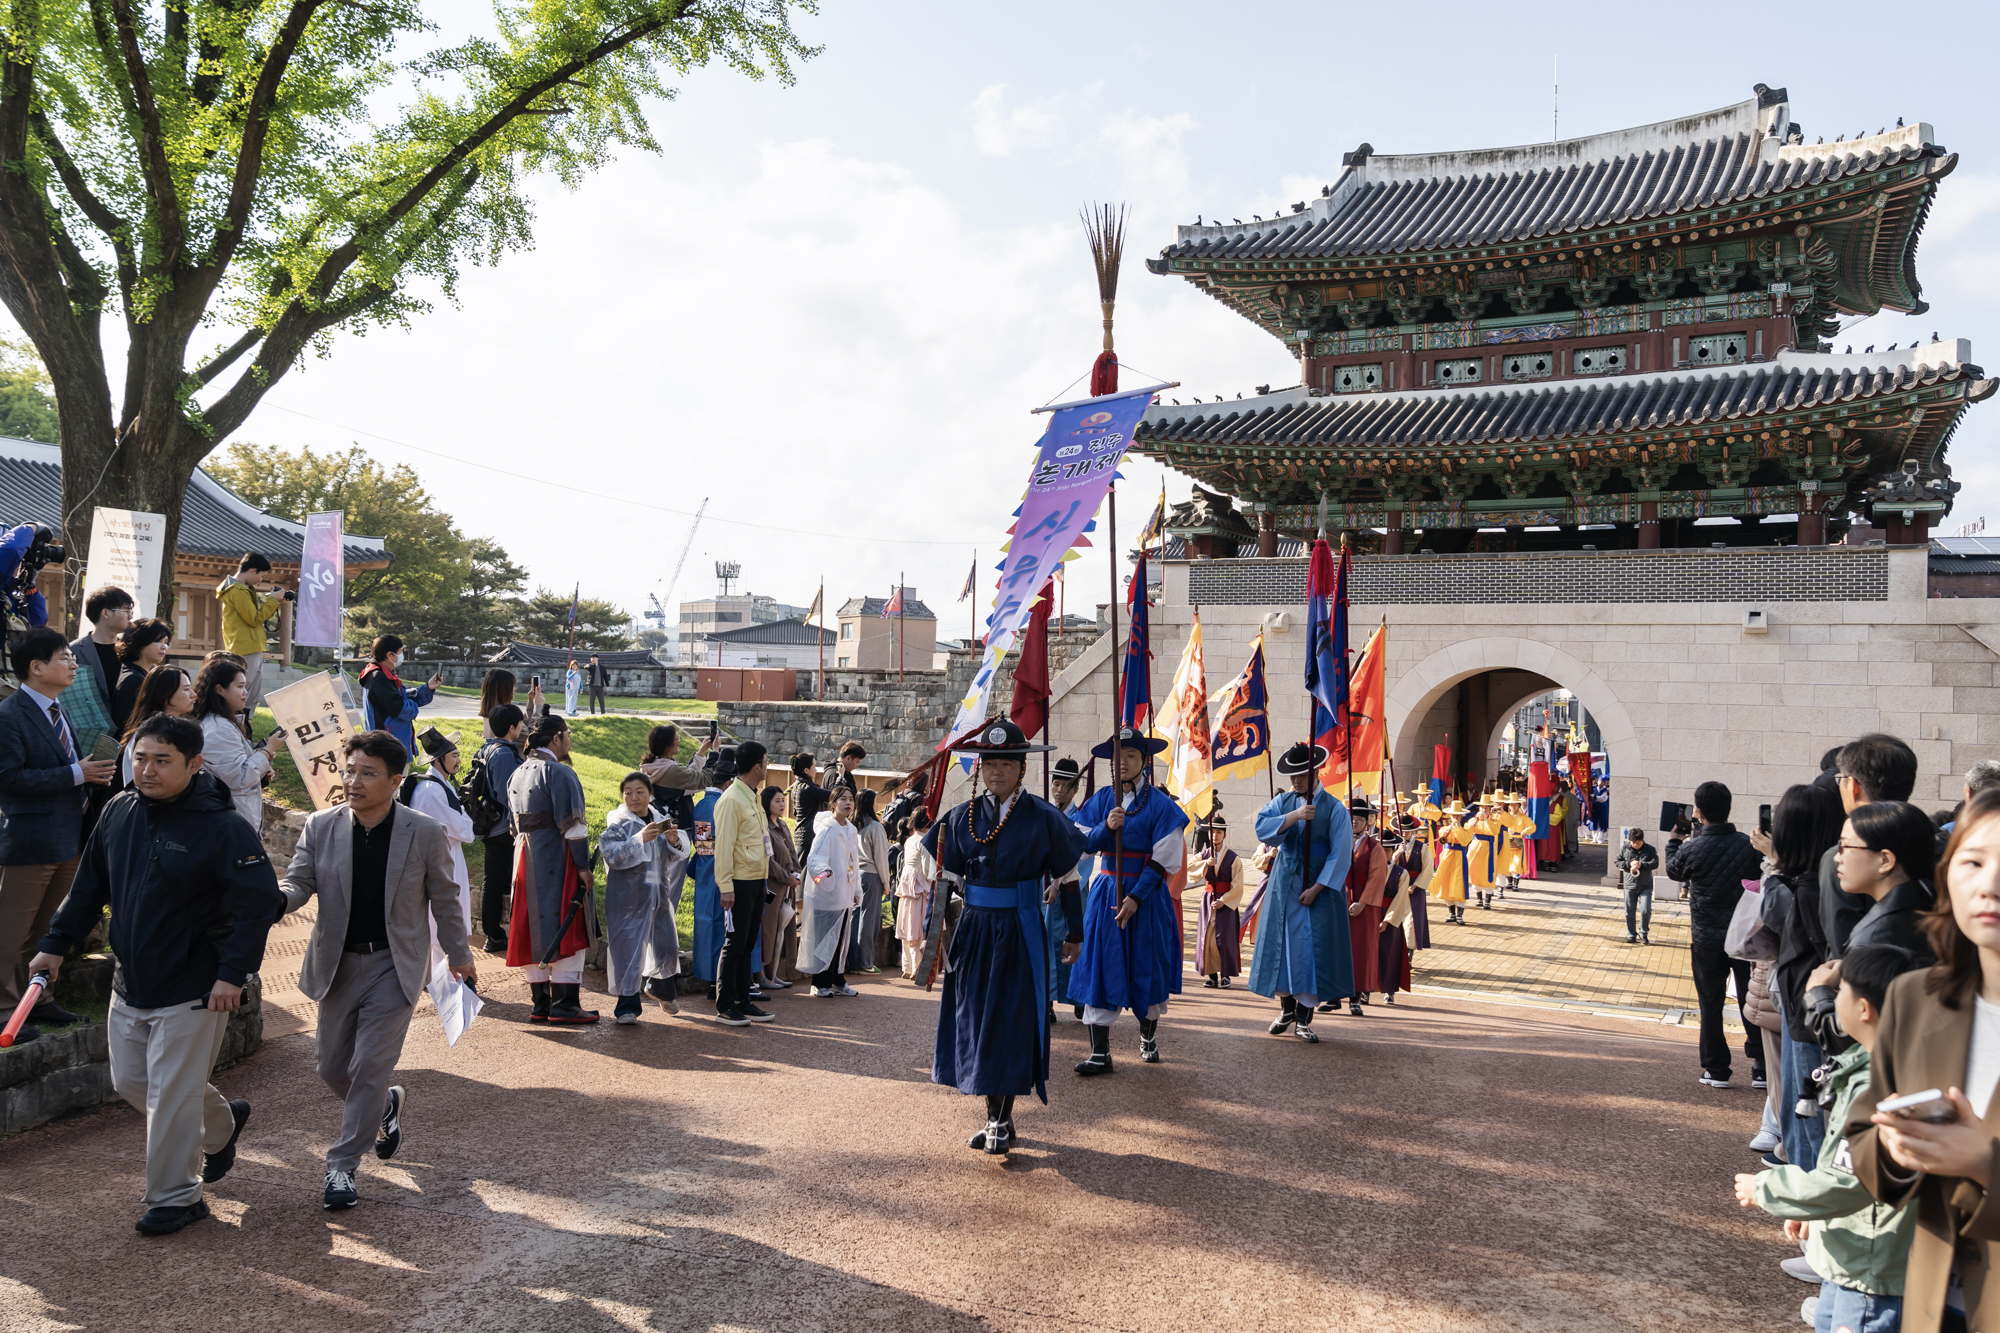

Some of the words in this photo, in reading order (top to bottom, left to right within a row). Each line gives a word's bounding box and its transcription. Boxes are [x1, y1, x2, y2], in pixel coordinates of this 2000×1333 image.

[1088, 433, 1123, 453] 진주
[1034, 448, 1123, 486] 논개제
[1056, 484, 1071, 492] Jinju
[1071, 479, 1092, 488] Nongae
